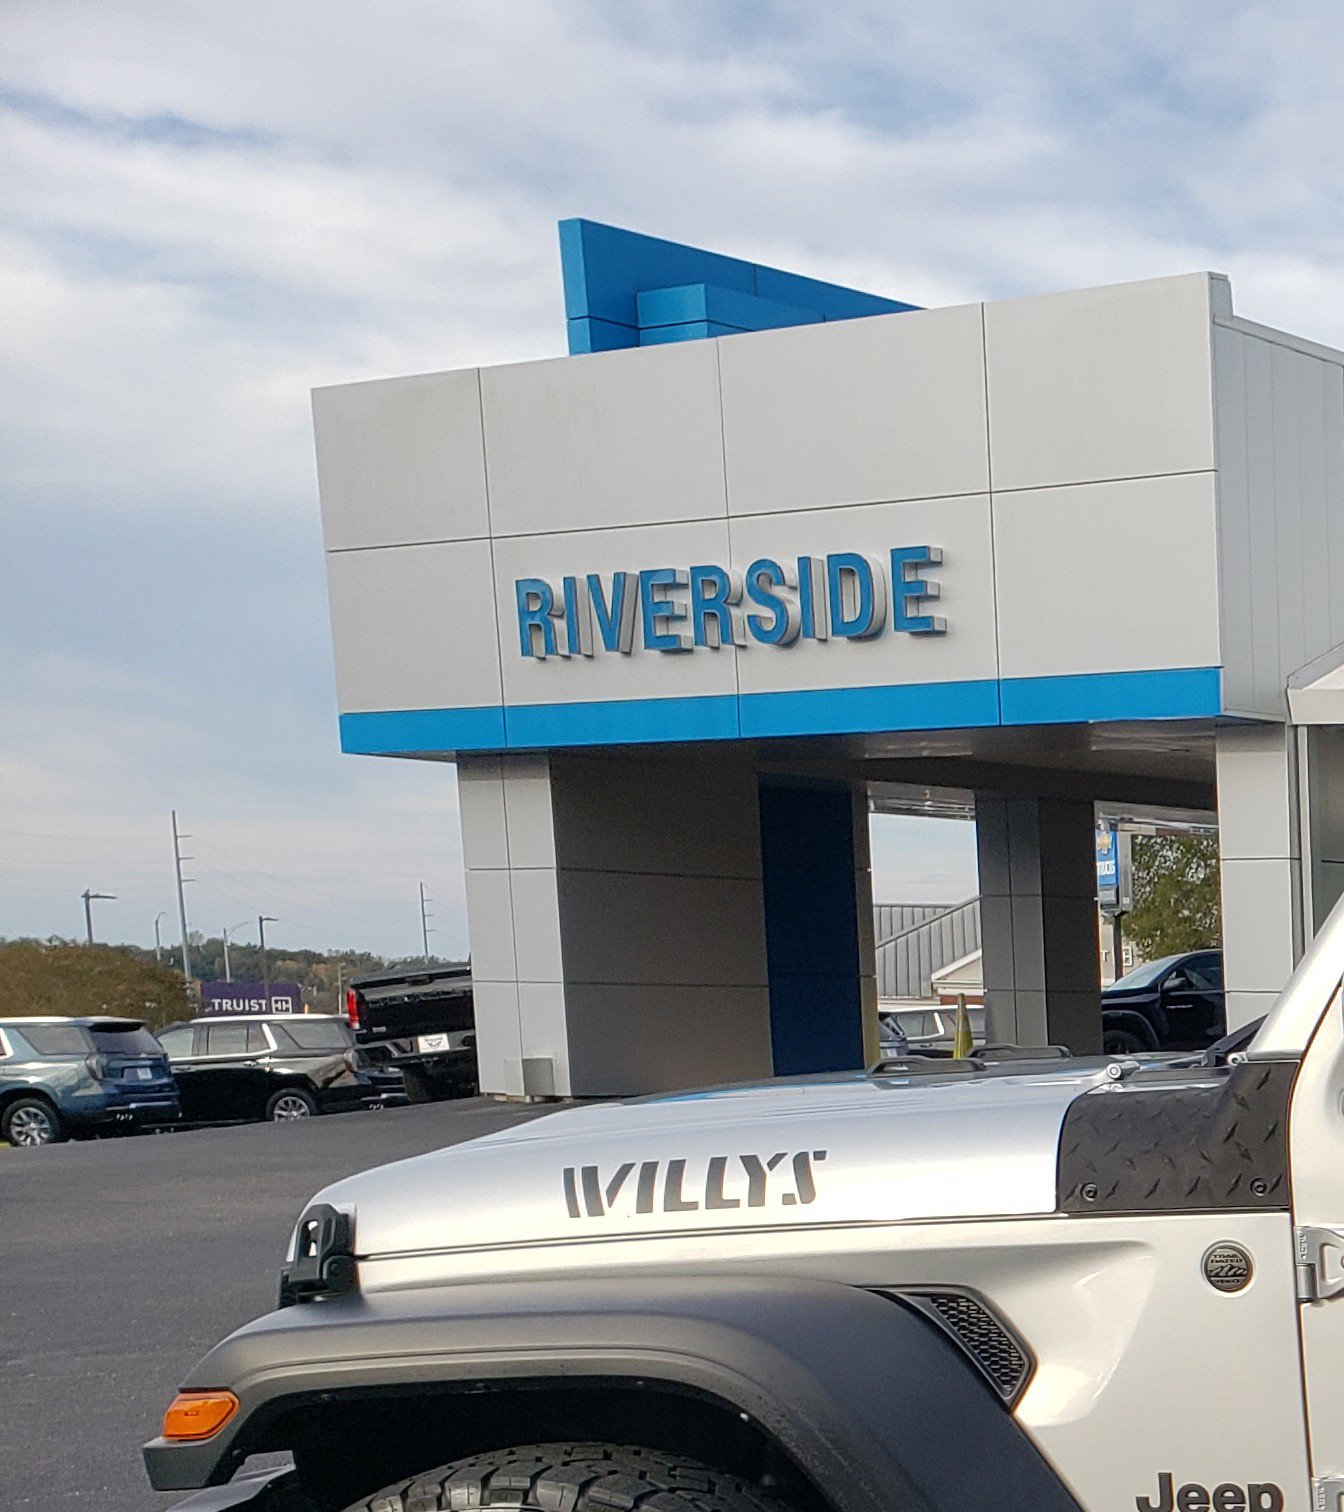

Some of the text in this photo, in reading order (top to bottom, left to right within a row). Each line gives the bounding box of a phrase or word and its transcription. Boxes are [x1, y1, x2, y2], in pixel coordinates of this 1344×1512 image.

[514, 545, 947, 660] RIVERSIDE
[211, 997, 267, 1012] TRUIST
[563, 1150, 827, 1218] WILLYS
